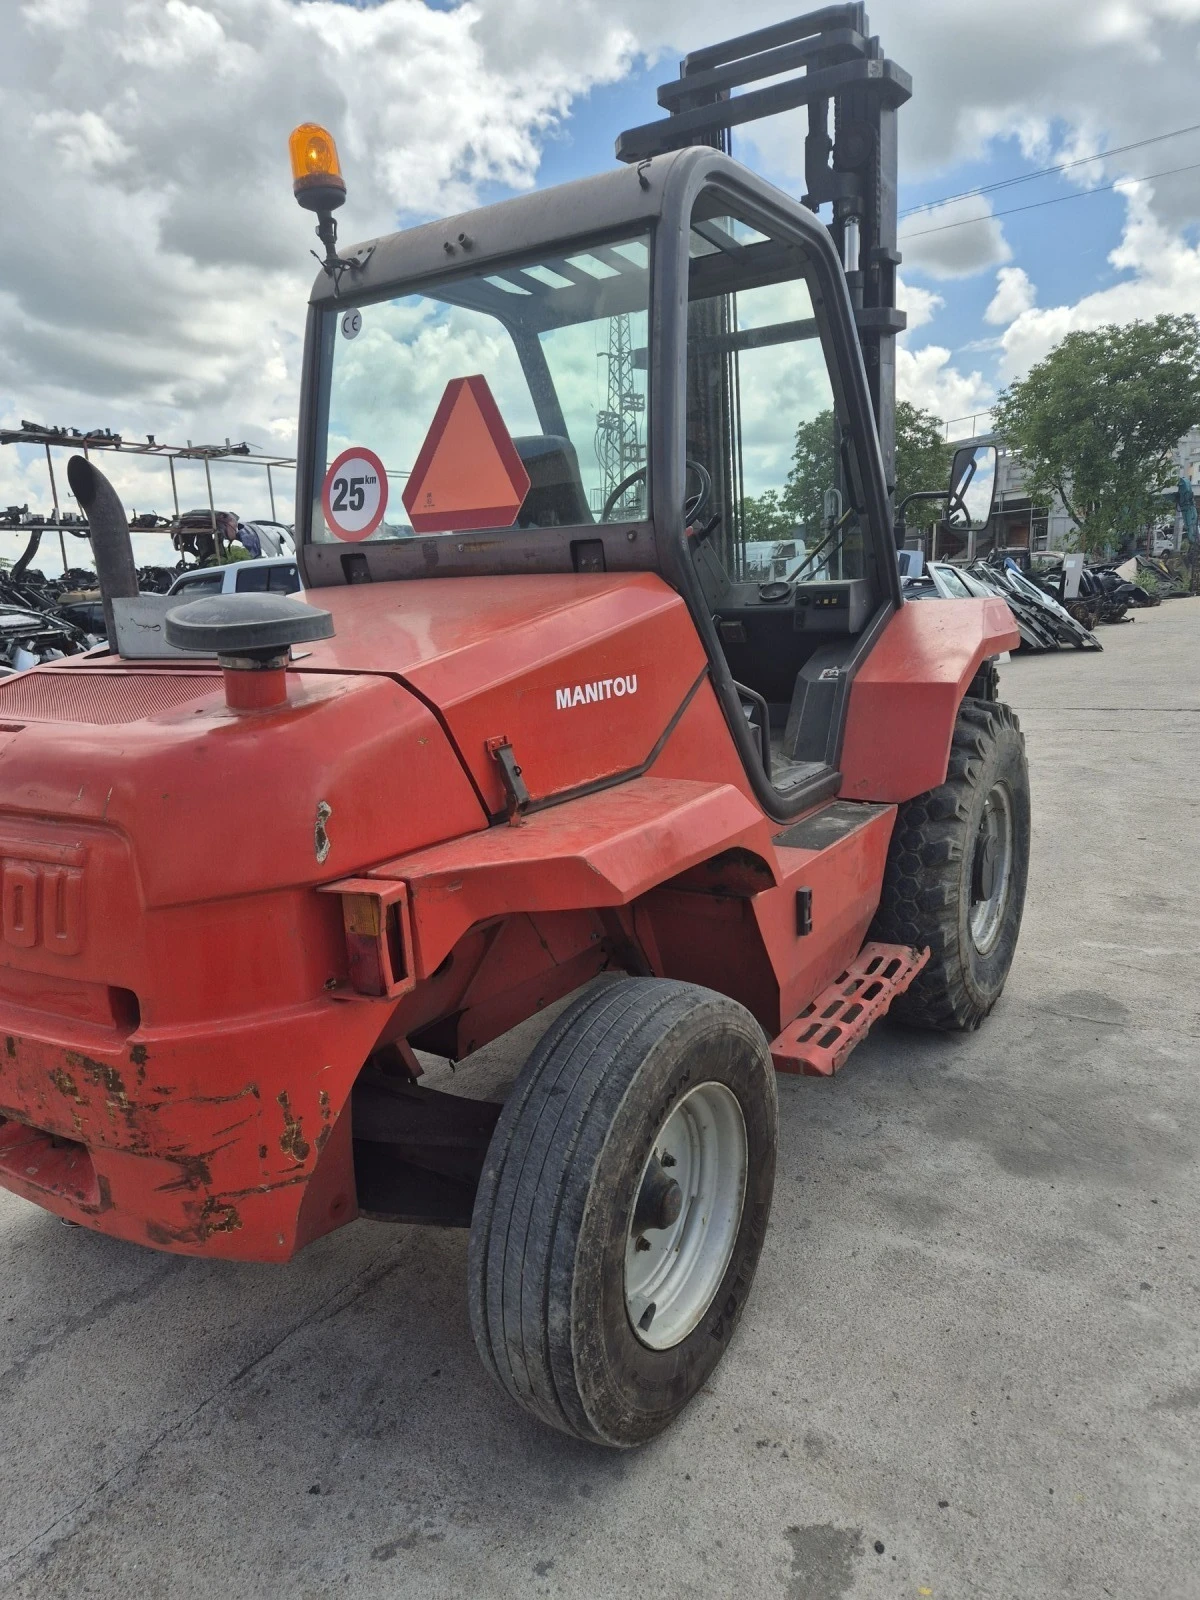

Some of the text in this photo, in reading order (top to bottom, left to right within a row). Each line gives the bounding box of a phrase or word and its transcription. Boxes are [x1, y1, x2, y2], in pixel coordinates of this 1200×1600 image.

[332, 475, 377, 511] 25 km
[556, 674, 637, 710] MANITOU
